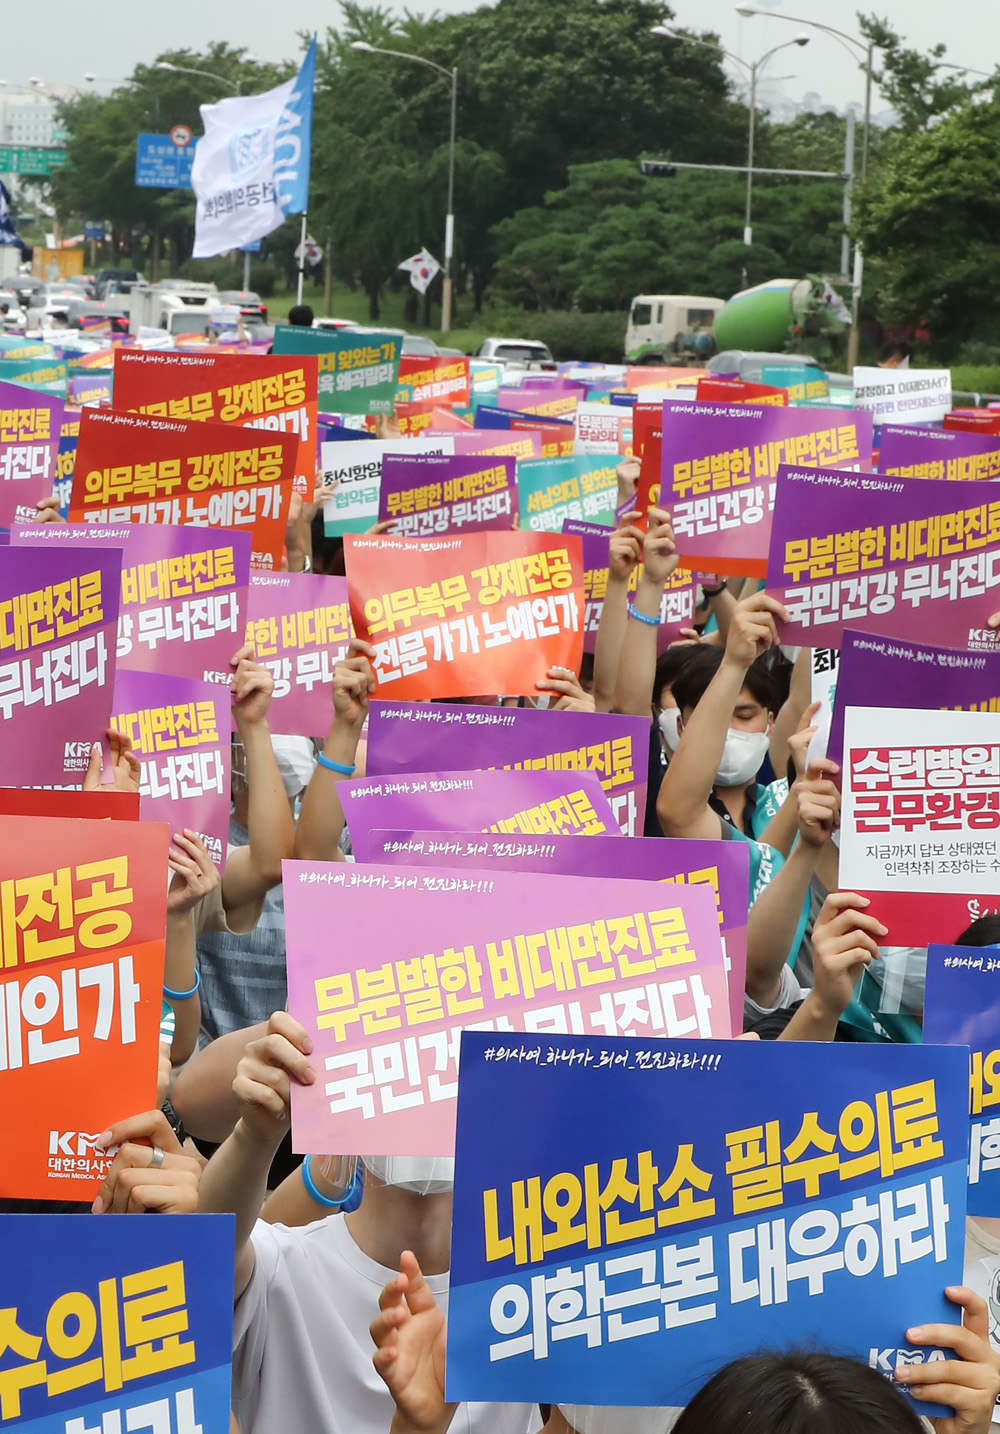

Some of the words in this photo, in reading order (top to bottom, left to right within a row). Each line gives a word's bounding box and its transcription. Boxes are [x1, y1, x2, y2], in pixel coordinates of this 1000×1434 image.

[121, 353, 215, 366] #의사여_하나가_되어_전진하라!!!
[217, 369, 306, 423] 강제전공
[88, 413, 187, 433] #의사여_하나가_되어_전진하라!!!
[83, 459, 182, 505] 의무복무
[186, 444, 283, 496] 강제전공
[672, 447, 752, 498] 무분별한
[754, 424, 859, 479] 비대면진료
[787, 473, 904, 493] #의사여_하나가_되어_전진하라!!!
[186, 484, 282, 527] 노예인가
[387, 482, 442, 516] 무분별한
[443, 465, 509, 502] 비대면진료
[451, 491, 511, 527] 무너진다
[672, 485, 764, 538] 국민건강
[353, 540, 462, 552] #의사여_하나가_되어_전진하라!!!
[783, 526, 886, 583] 무분별한
[121, 546, 236, 605] 비대면진료
[364, 574, 471, 636] 의무복무
[471, 548, 573, 605] 강제전공
[138, 592, 239, 650] 무너진다
[784, 571, 898, 628] 국민건강
[372, 614, 480, 685] 전문가가
[484, 592, 579, 649] 노예인가
[380, 709, 516, 727] #의사여_하나가_되어_전진하라!!!
[350, 778, 474, 799] #의사여_하나가_되어_전진하라!!!
[852, 746, 1000, 790] 수련병원
[853, 792, 1000, 834] 근무환경
[383, 841, 556, 859] #의사여_하나가_되어_전진하라!!!
[865, 843, 917, 859] 지금까지
[919, 843, 945, 857] 답보
[947, 841, 997, 857] 상태였던
[884, 861, 934, 876] 인력착취
[937, 859, 987, 874] 조장하는
[299, 871, 495, 895] #의사여_하나가_되어_전진하라!!!
[313, 944, 486, 1044] 무분별한
[485, 905, 697, 1002] 비대면진료
[483, 1045, 722, 1072] #의사여_하나가_되어_전진하라!!!
[483, 1143, 716, 1267] 내외산소
[724, 1078, 945, 1216] 필수의료
[488, 1235, 720, 1363] 의학근본
[727, 1176, 950, 1307] 대우하라
